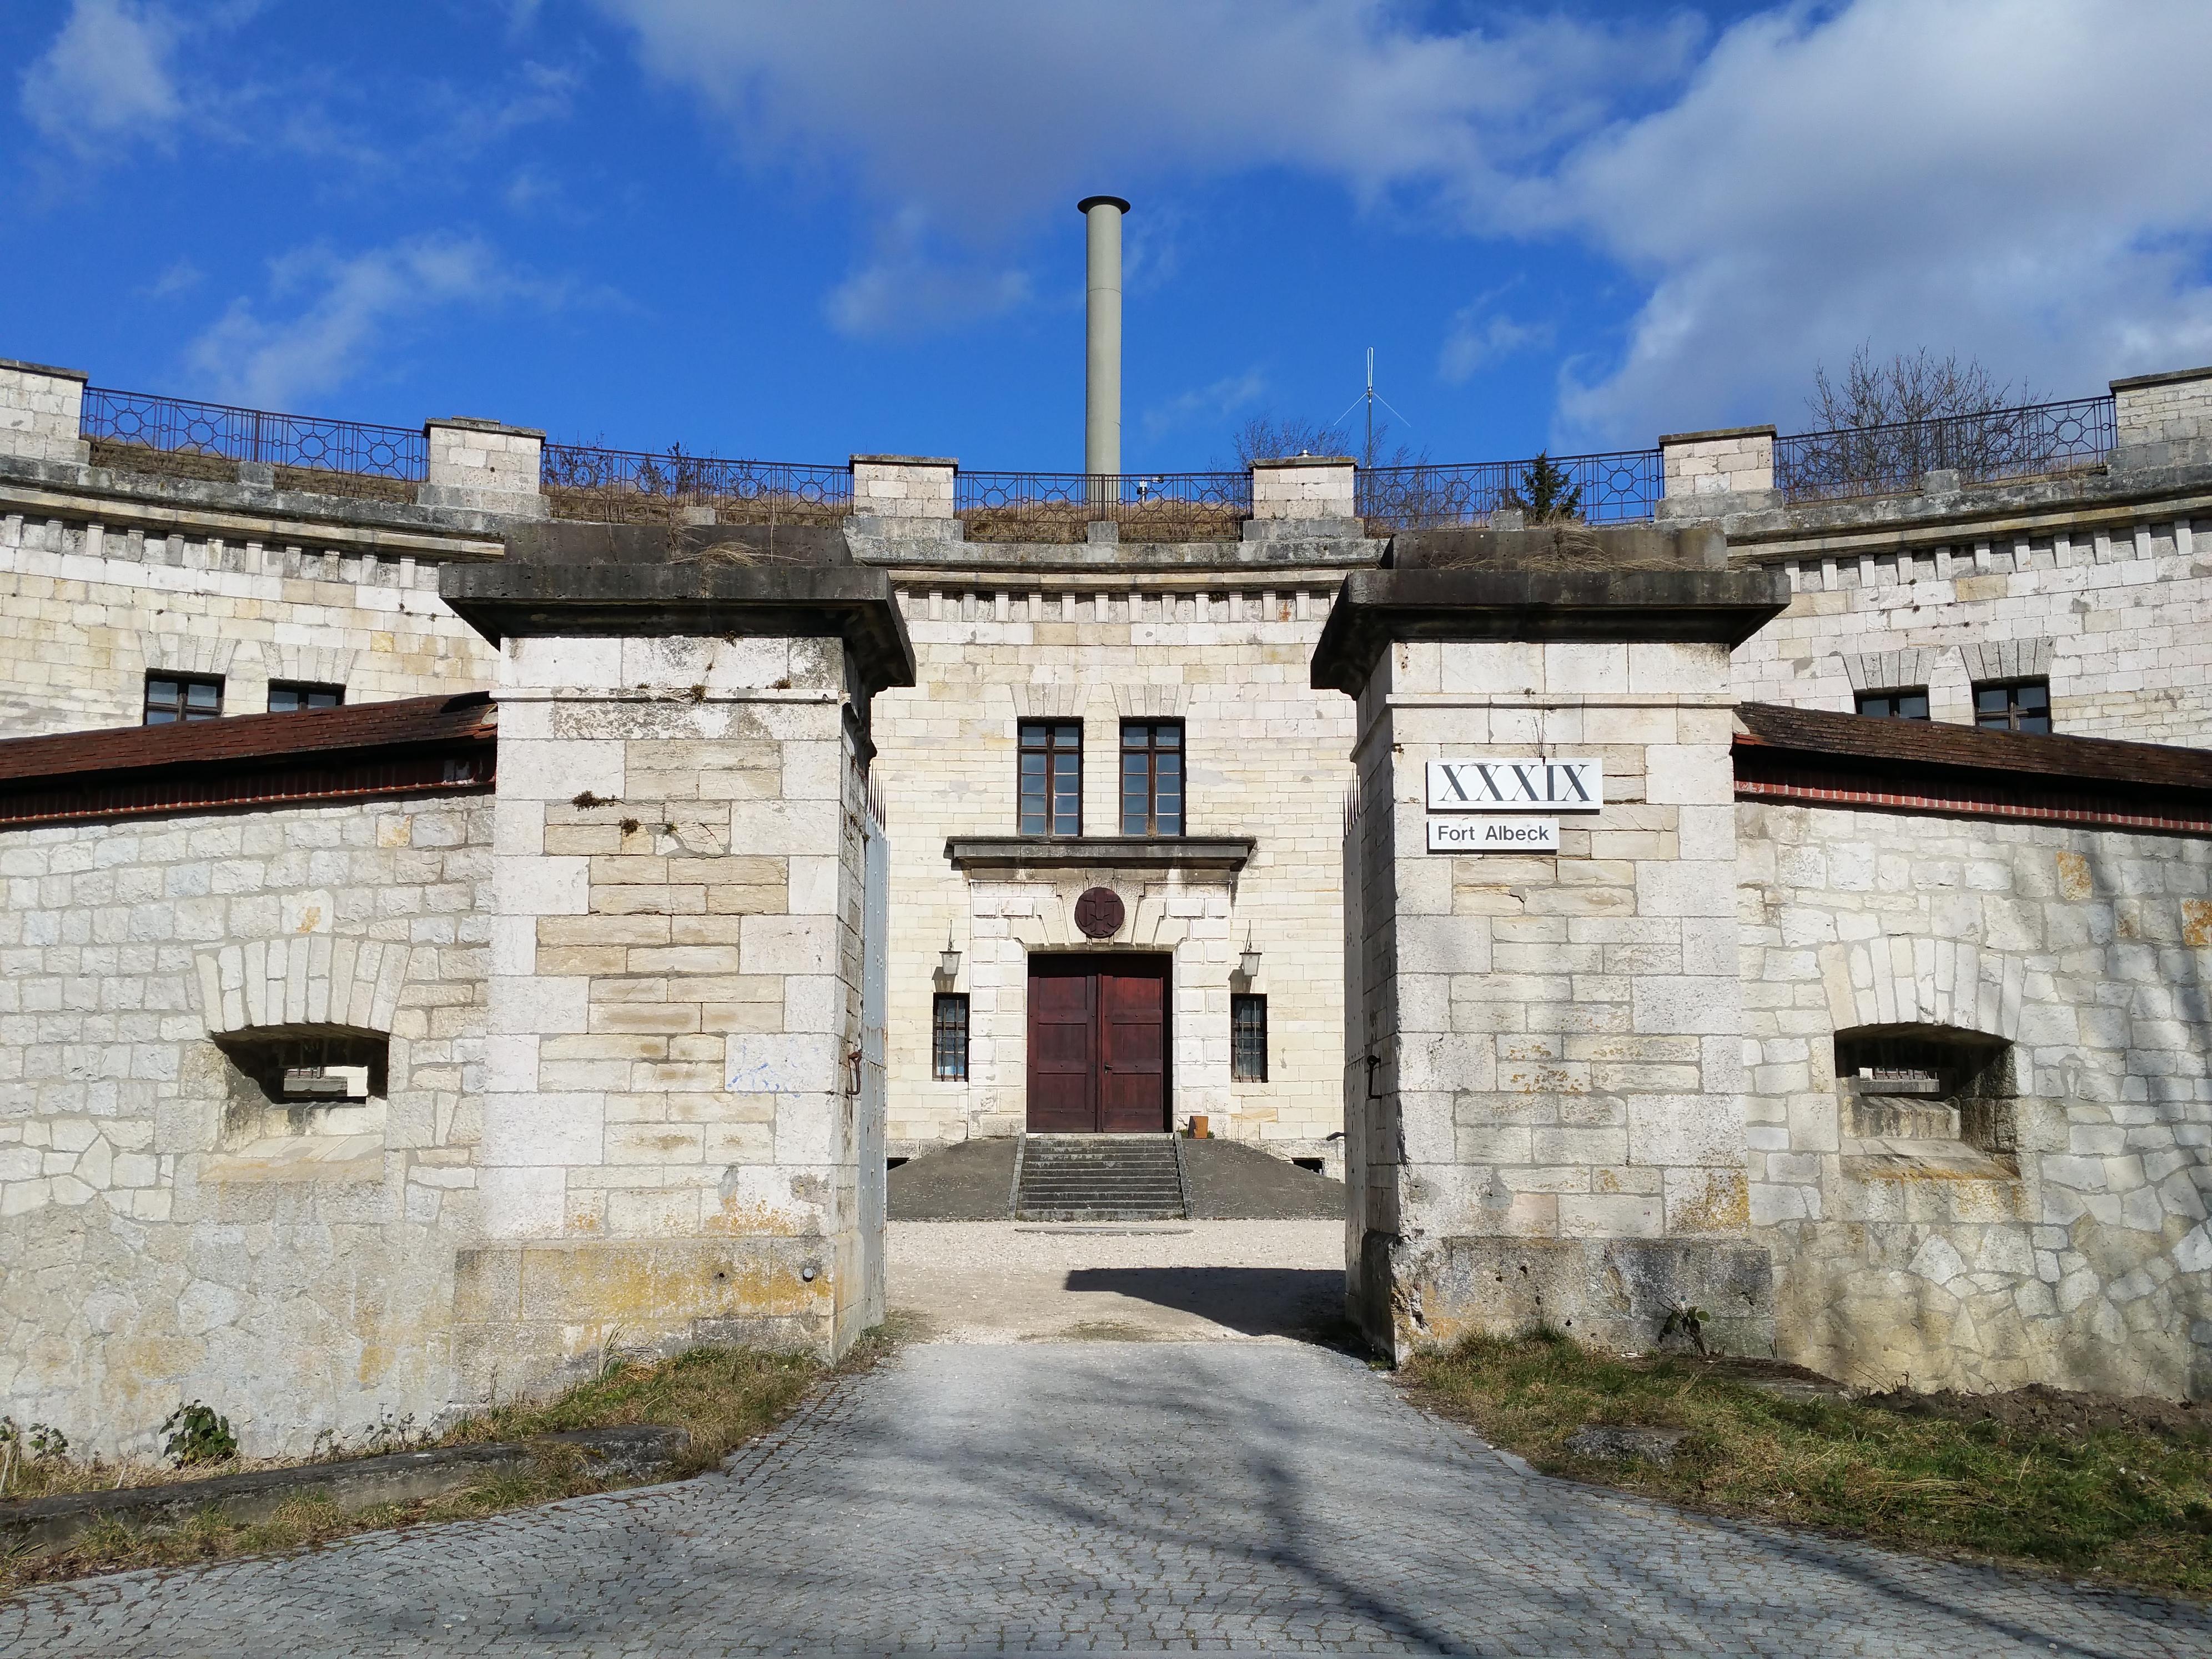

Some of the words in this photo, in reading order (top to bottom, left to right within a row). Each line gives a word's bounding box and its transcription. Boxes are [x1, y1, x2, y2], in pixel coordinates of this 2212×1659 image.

[1437, 764, 1594, 802] XXXIX
[1438, 825, 1475, 841] Fort
[1485, 825, 1550, 841] Albeck
